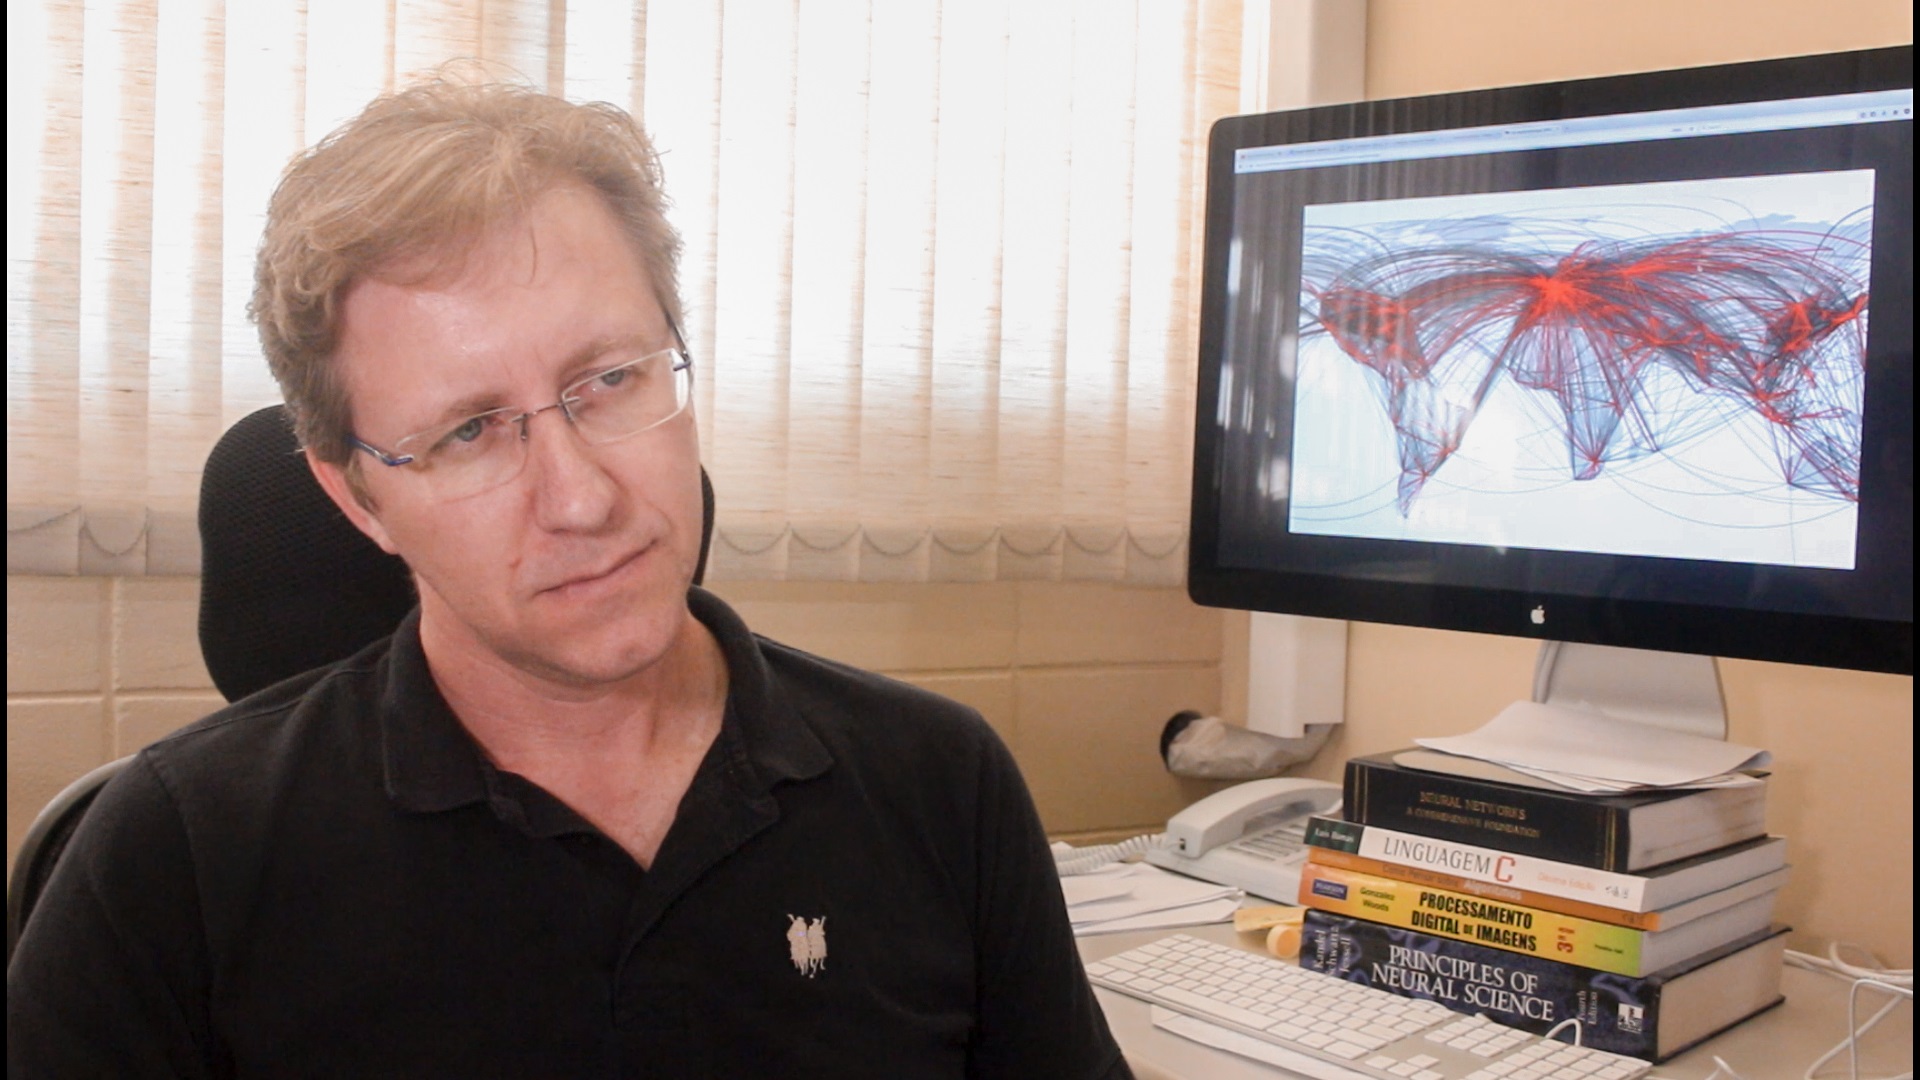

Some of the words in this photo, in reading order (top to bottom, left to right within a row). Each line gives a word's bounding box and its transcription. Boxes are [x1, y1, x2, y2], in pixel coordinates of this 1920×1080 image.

[1383, 837, 1491, 875] LINGUAGEM
[1494, 855, 1516, 883] C
[1411, 910, 1460, 935] DIGITAL
[1463, 923, 1474, 935] DE
[1476, 924, 1537, 951] IMAGENS
[1419, 891, 1533, 929] PROCESSAMENTO
[1313, 929, 1327, 969] Kandel
[1388, 944, 1505, 988] PRINCIPLES
[1510, 970, 1539, 995] OF
[1371, 962, 1459, 1000] NEURAL
[1463, 982, 1556, 1022] SCIENCE
